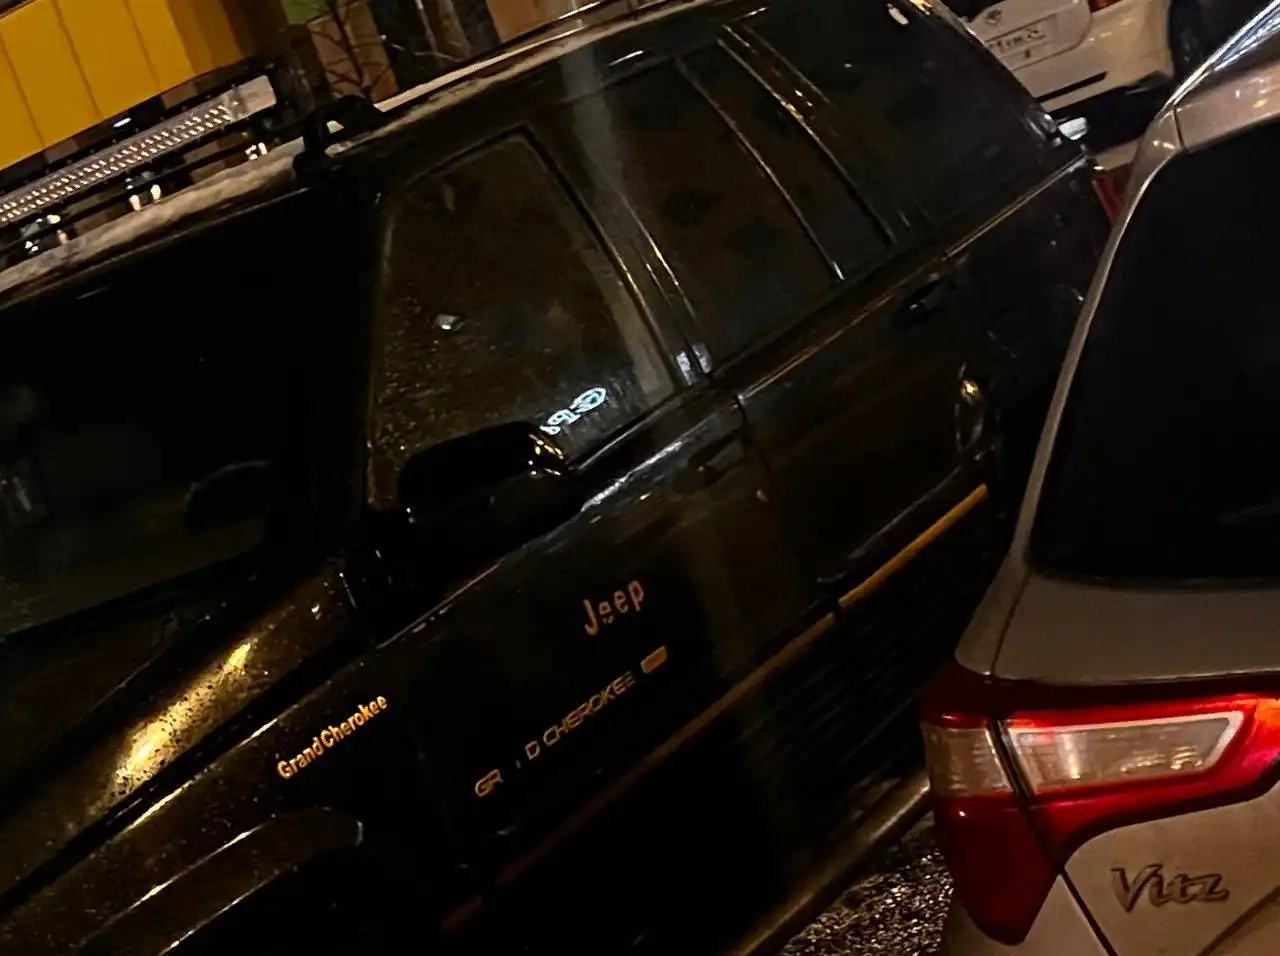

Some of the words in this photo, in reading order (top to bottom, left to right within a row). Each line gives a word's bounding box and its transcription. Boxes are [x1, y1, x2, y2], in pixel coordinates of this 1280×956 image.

[582, 579, 645, 637] Jeep
[276, 735, 325, 780] Grand
[320, 695, 388, 748] Cherokee
[474, 739, 541, 797] GRD
[543, 669, 637, 747] CHEROKEE
[1110, 863, 1231, 914] Vitz
